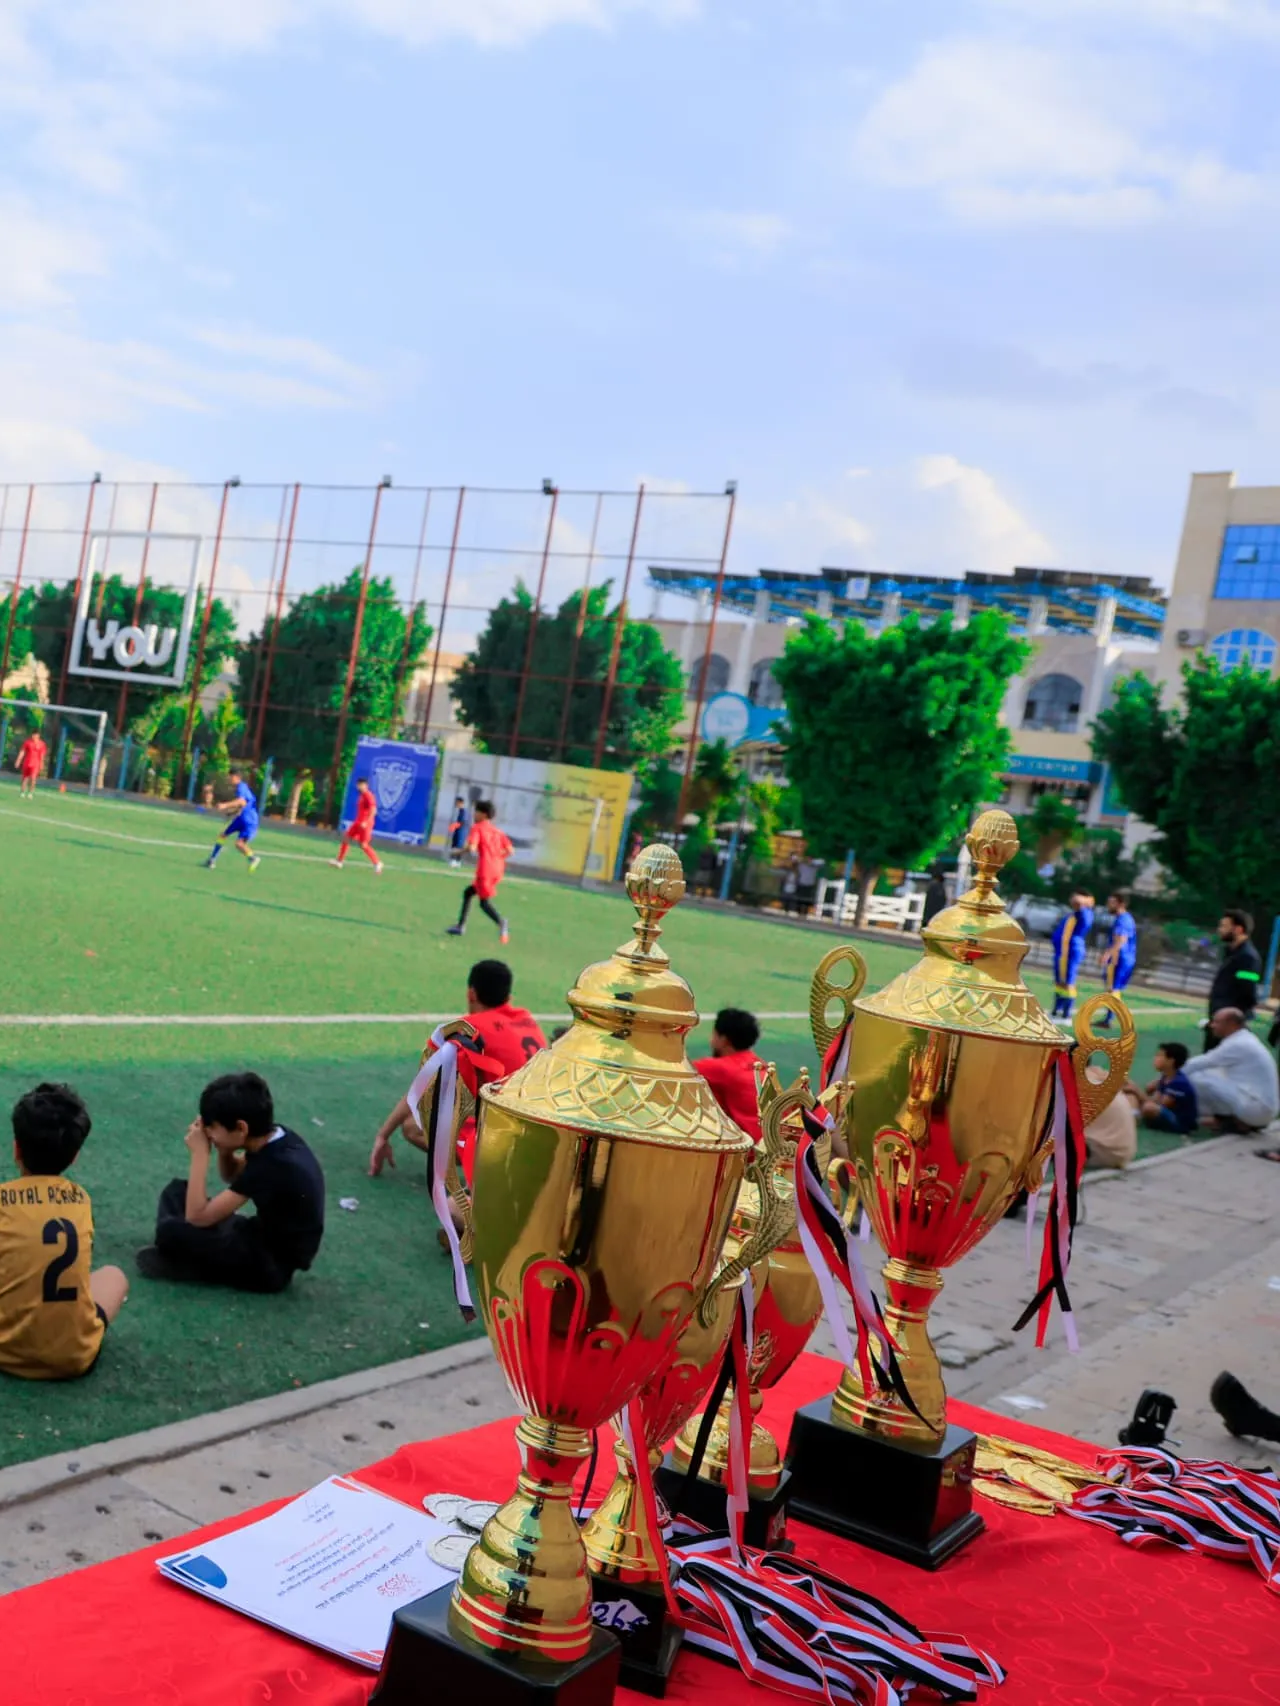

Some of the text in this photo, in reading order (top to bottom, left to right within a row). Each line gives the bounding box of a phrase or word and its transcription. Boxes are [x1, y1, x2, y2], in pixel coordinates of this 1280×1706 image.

[86, 618, 177, 667] YOU
[0, 1186, 43, 1206] ROYAL
[42, 1217, 79, 1303] 2
